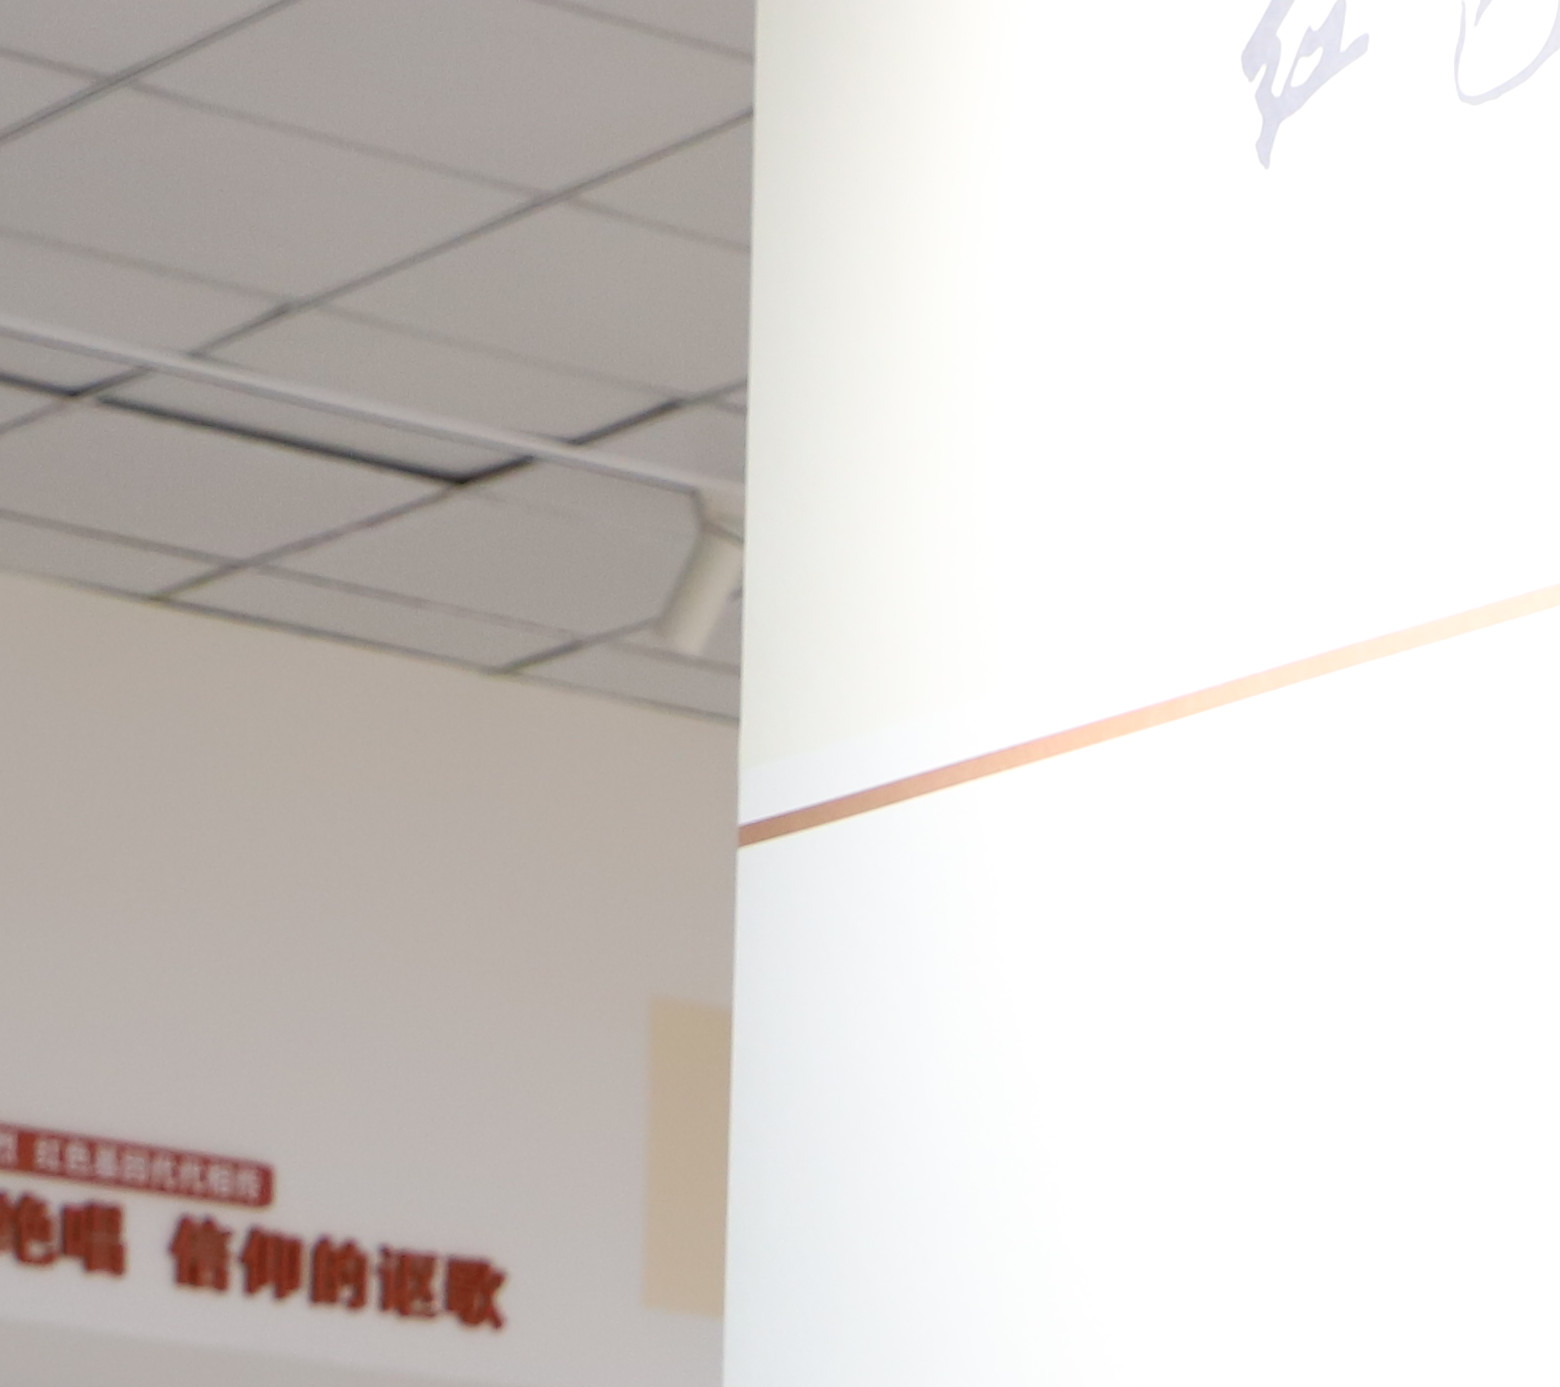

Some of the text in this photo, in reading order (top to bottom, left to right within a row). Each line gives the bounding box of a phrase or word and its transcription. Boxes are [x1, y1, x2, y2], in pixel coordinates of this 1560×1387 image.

[167, 1213, 508, 1331] 信仰的讴歌
